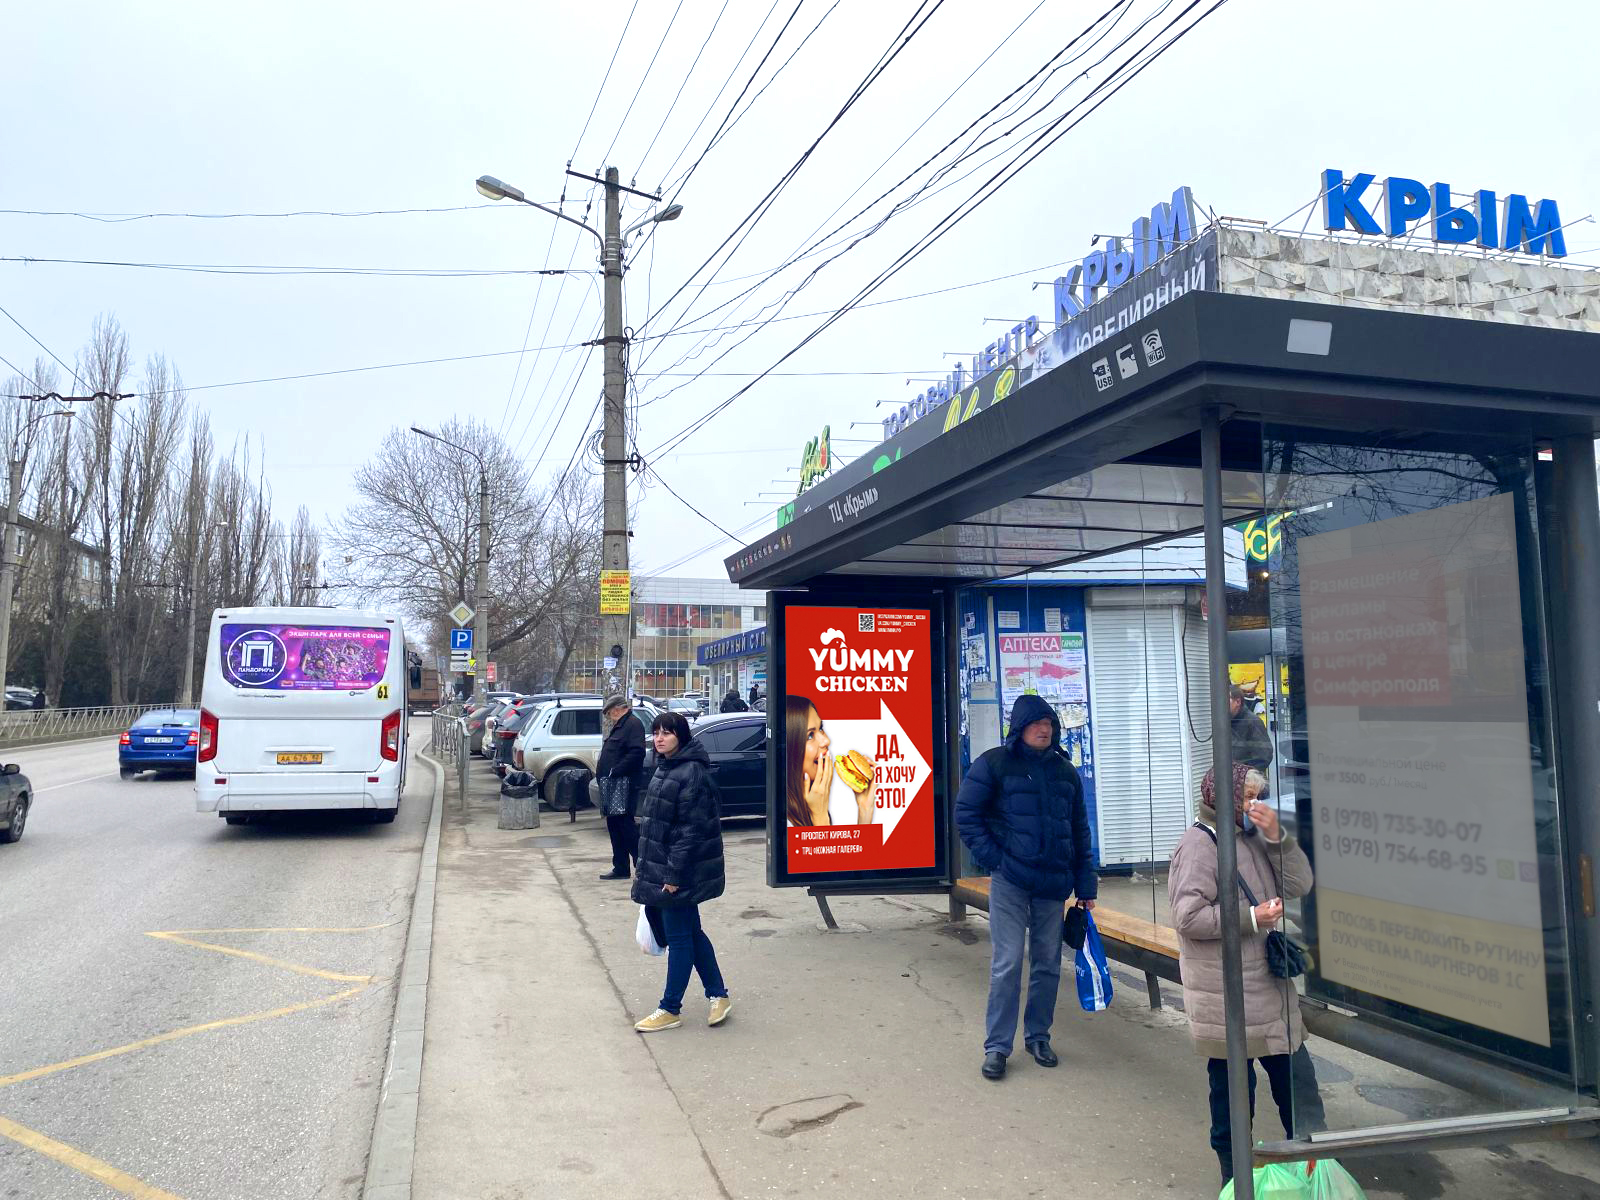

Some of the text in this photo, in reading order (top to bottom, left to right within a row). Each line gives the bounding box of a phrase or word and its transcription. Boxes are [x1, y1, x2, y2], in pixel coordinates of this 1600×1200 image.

[1321, 168, 1567, 258] КРЫМ
[1054, 186, 1197, 324] КРЫМ
[882, 361, 965, 441] ТОРГОВЫЙ
[973, 315, 1039, 382] ЦЕНТР
[1097, 375, 1113, 389] USB
[828, 487, 879, 524] ТЦ «Крым»
[1309, 566, 1420, 594] Размещение
[1310, 600, 1386, 623] рекламы
[456, 631, 469, 648] P
[1311, 620, 1438, 644] на остановках
[704, 633, 746, 660] ЮВЕЛИРНЫЙ
[1003, 637, 1060, 652] АПТЕКА
[808, 647, 914, 672] YUMMY
[1312, 652, 1387, 671] в центре
[377, 686, 388, 699] 61
[815, 676, 908, 692] CHICKEN
[1312, 677, 1440, 696] Симферополя
[875, 734, 905, 763] ДА,
[875, 765, 916, 784] Я ХОЧУ
[1415, 760, 1447, 772] цене
[1338, 771, 1367, 785] 3500
[875, 788, 906, 809] ЭТО!
[801, 831, 829, 840] ПРОСПЕКТ
[853, 829, 861, 839] 27
[1320, 807, 1482, 843] 8 (978) 735-30-07
[802, 847, 812, 855] ТРЦ
[1322, 834, 1488, 875] 8 (978) 754-68-95
[1330, 909, 1542, 968] СПОСОБ ПЕРЕЛОЖИТЬ РУТИНУ
[1331, 929, 1526, 990] БУХУЧЕТА НА ПАРТНЕРОВ 1С
